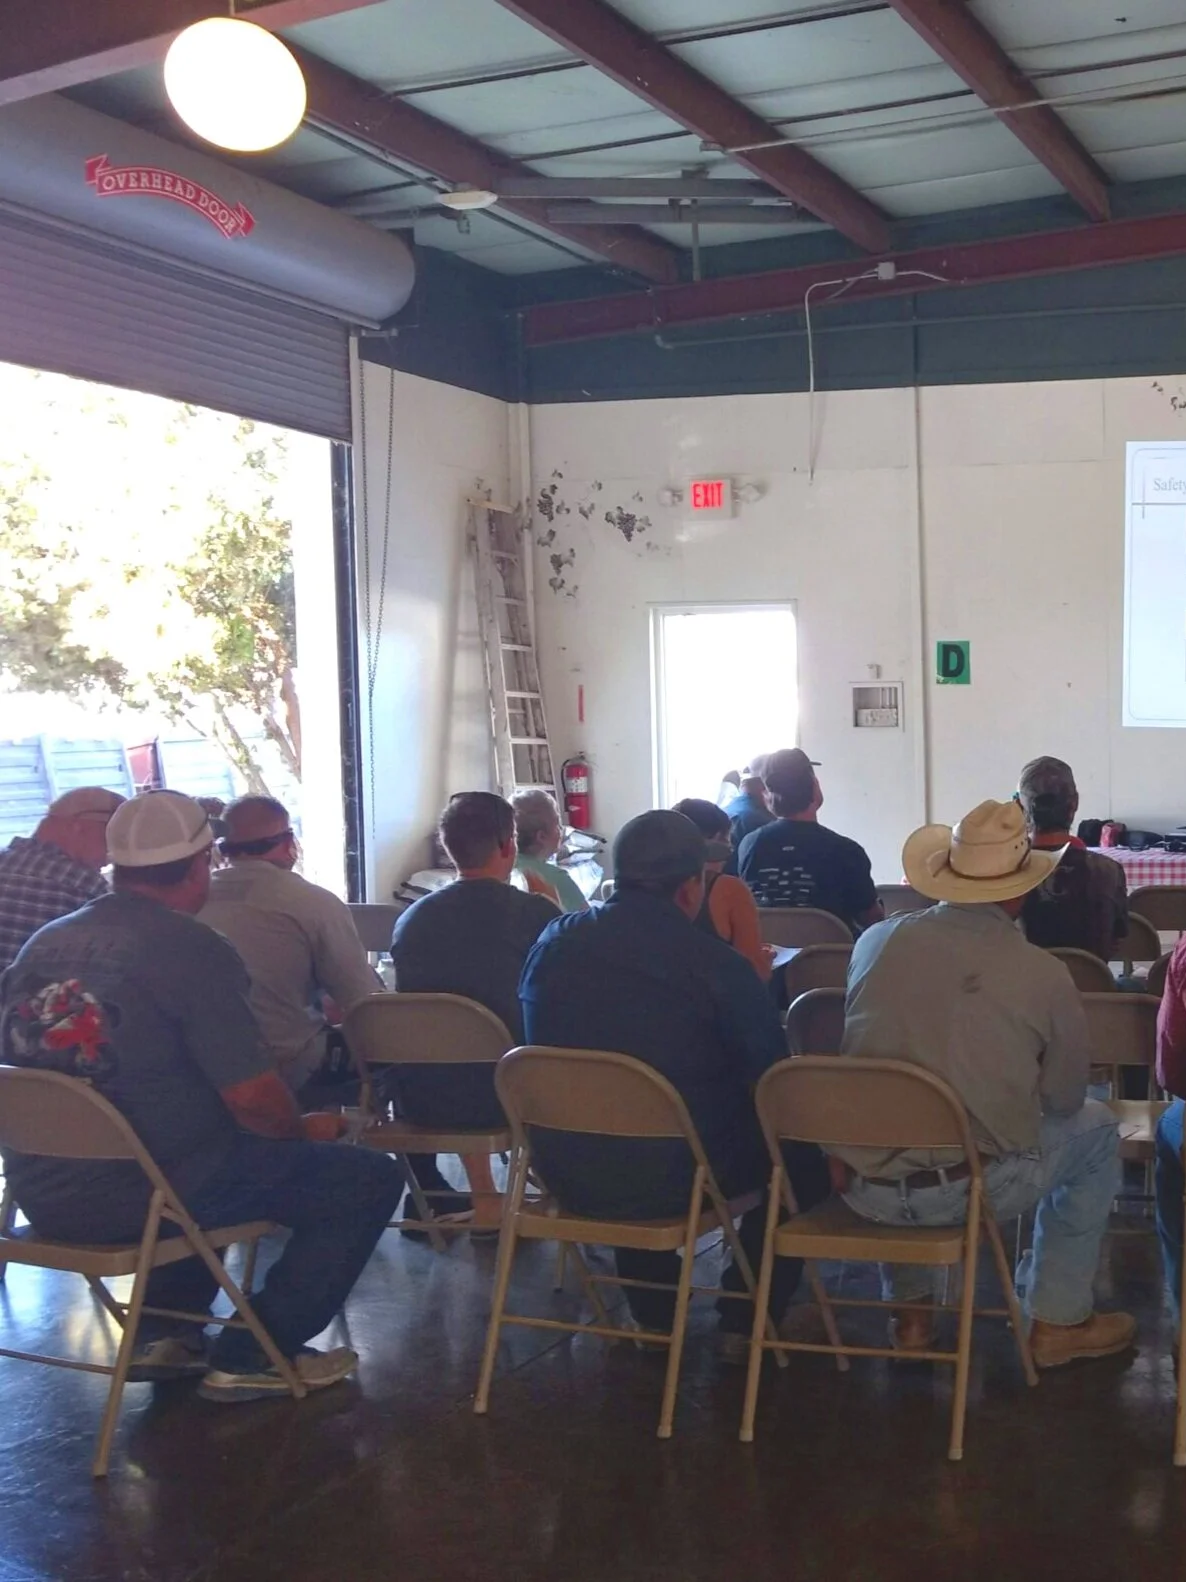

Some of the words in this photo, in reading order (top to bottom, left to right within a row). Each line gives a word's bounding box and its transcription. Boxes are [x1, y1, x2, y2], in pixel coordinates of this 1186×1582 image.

[102, 172, 197, 200] OVERHEAD
[199, 191, 238, 234] DOOR
[692, 482, 724, 509] EXIT
[941, 643, 965, 679] D
